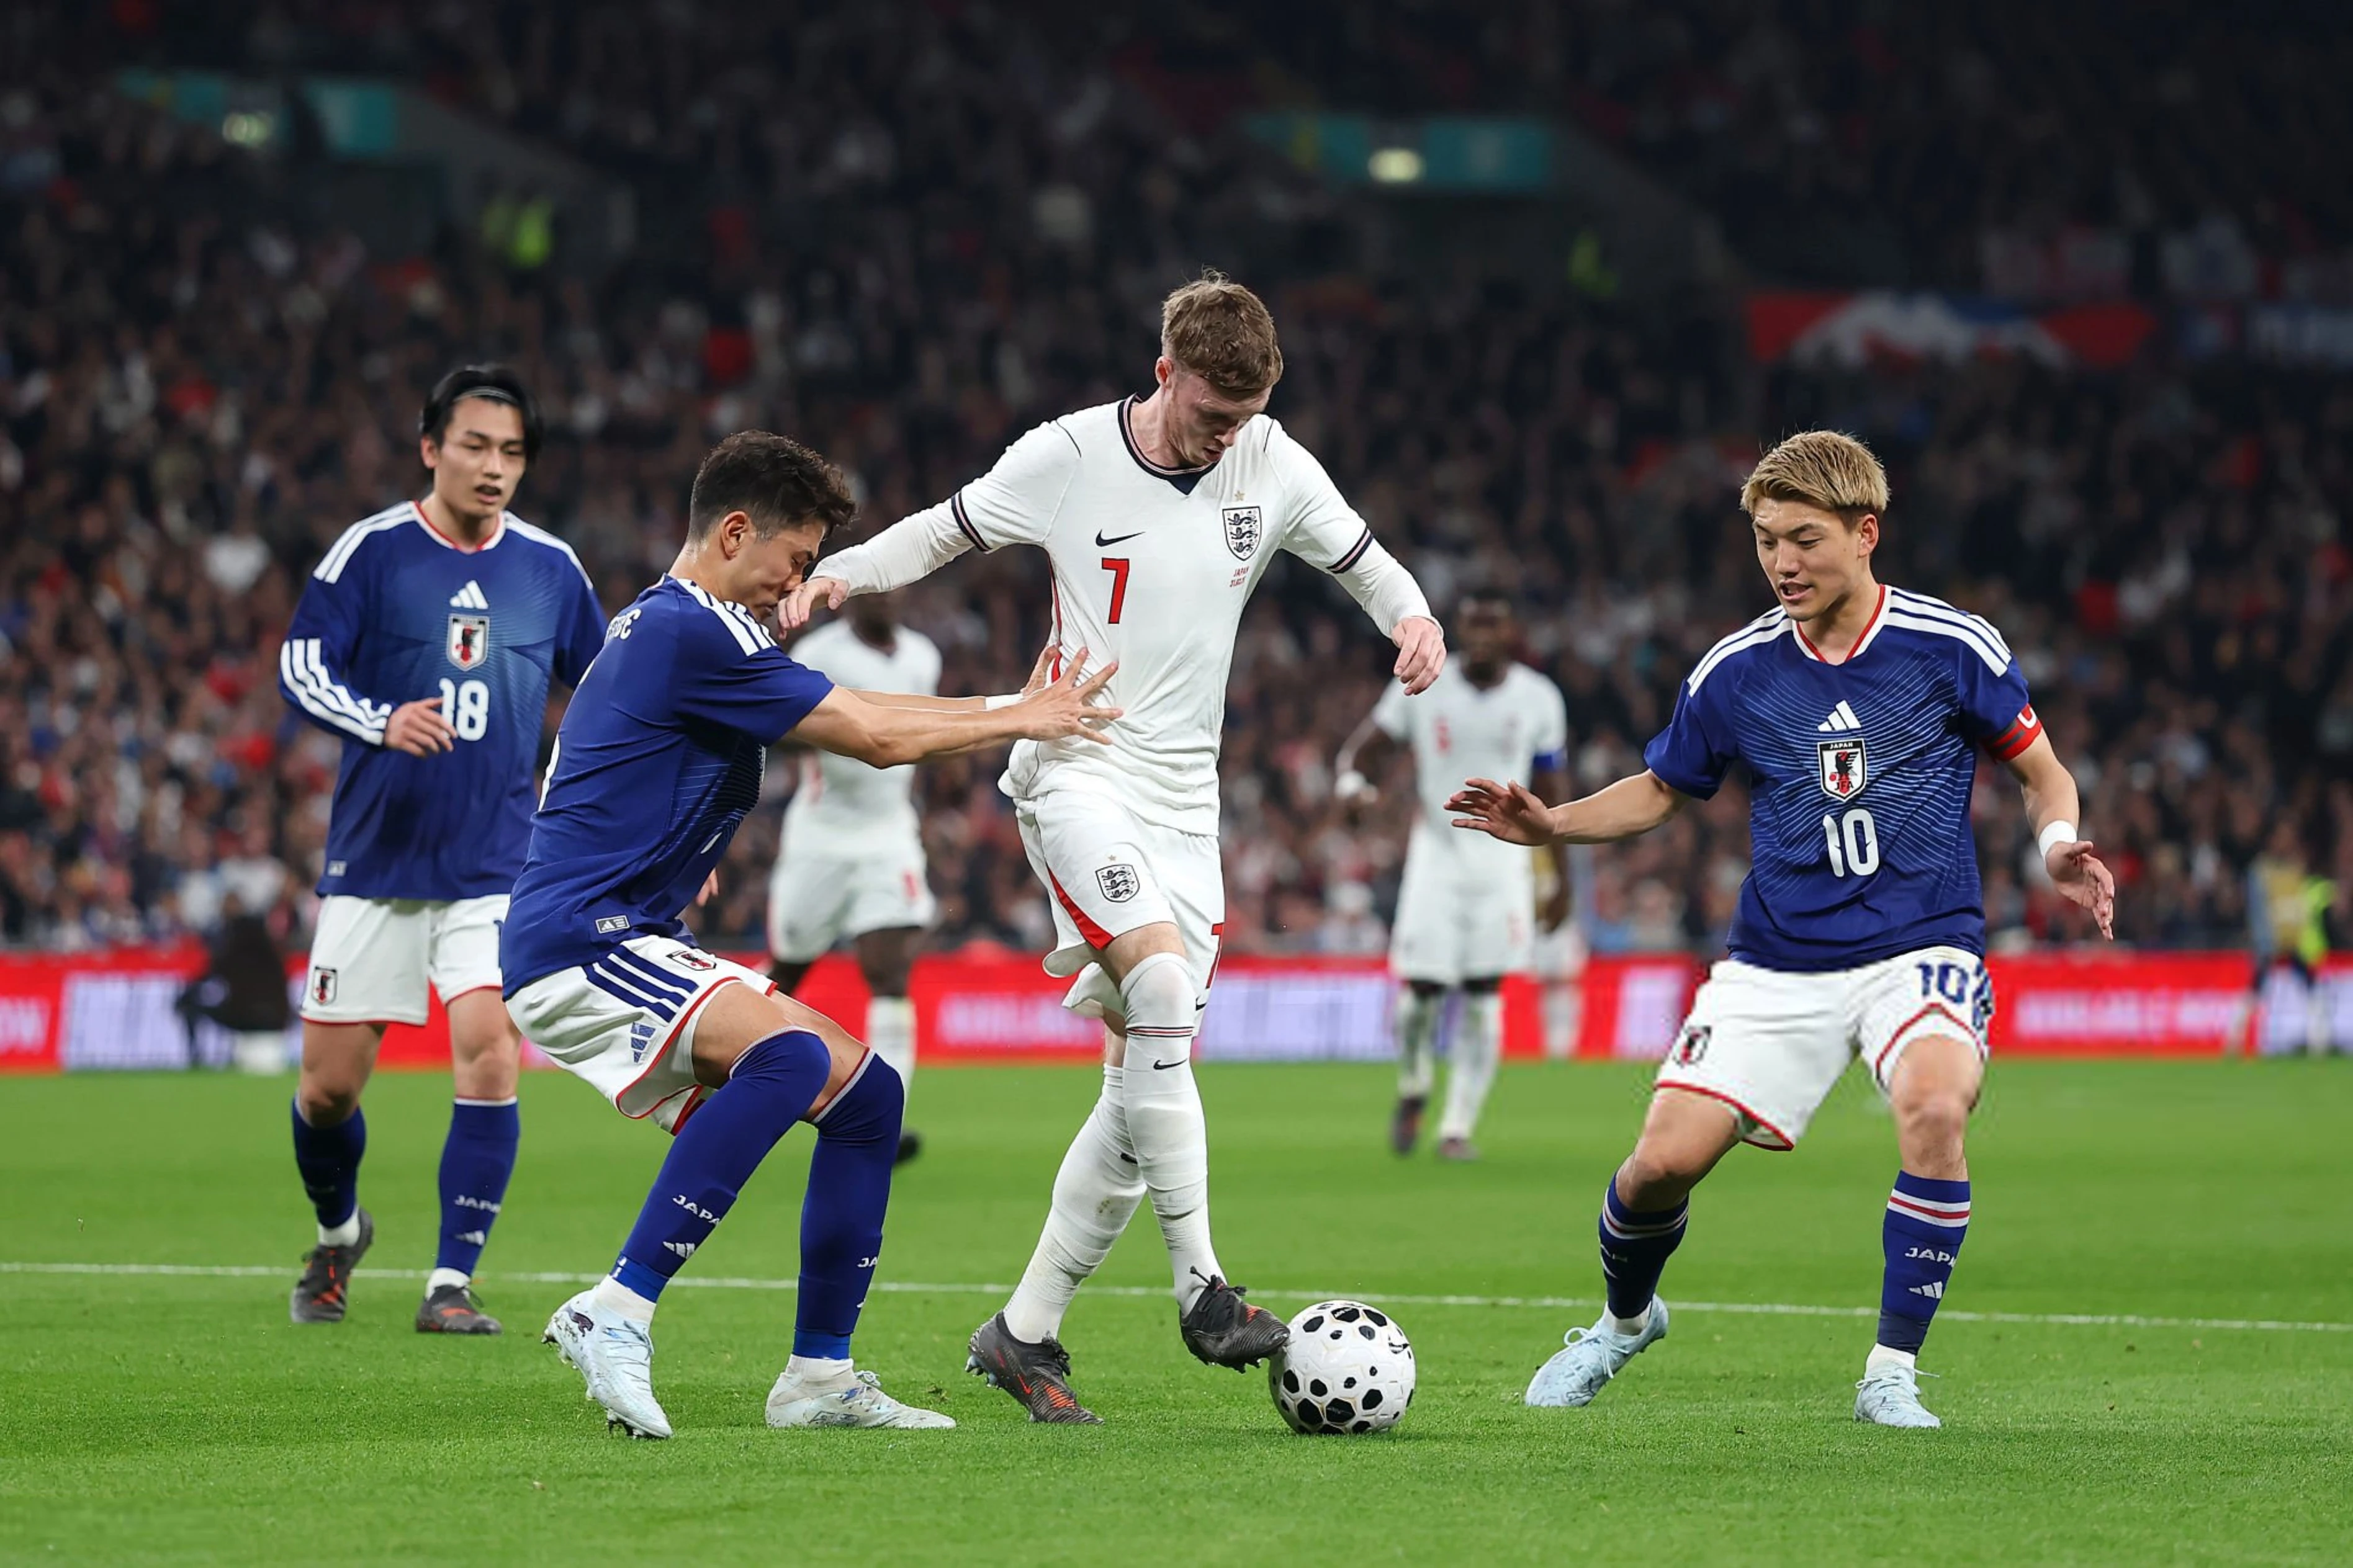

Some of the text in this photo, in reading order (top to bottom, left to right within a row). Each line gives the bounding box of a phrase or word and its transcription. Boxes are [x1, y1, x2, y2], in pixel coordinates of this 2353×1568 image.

[1101, 557, 1130, 624] 7
[438, 677, 489, 741] 18
[1829, 741, 1854, 750] JAPAN
[1822, 808, 1879, 877] 10
[1915, 962, 1969, 1005] 10
